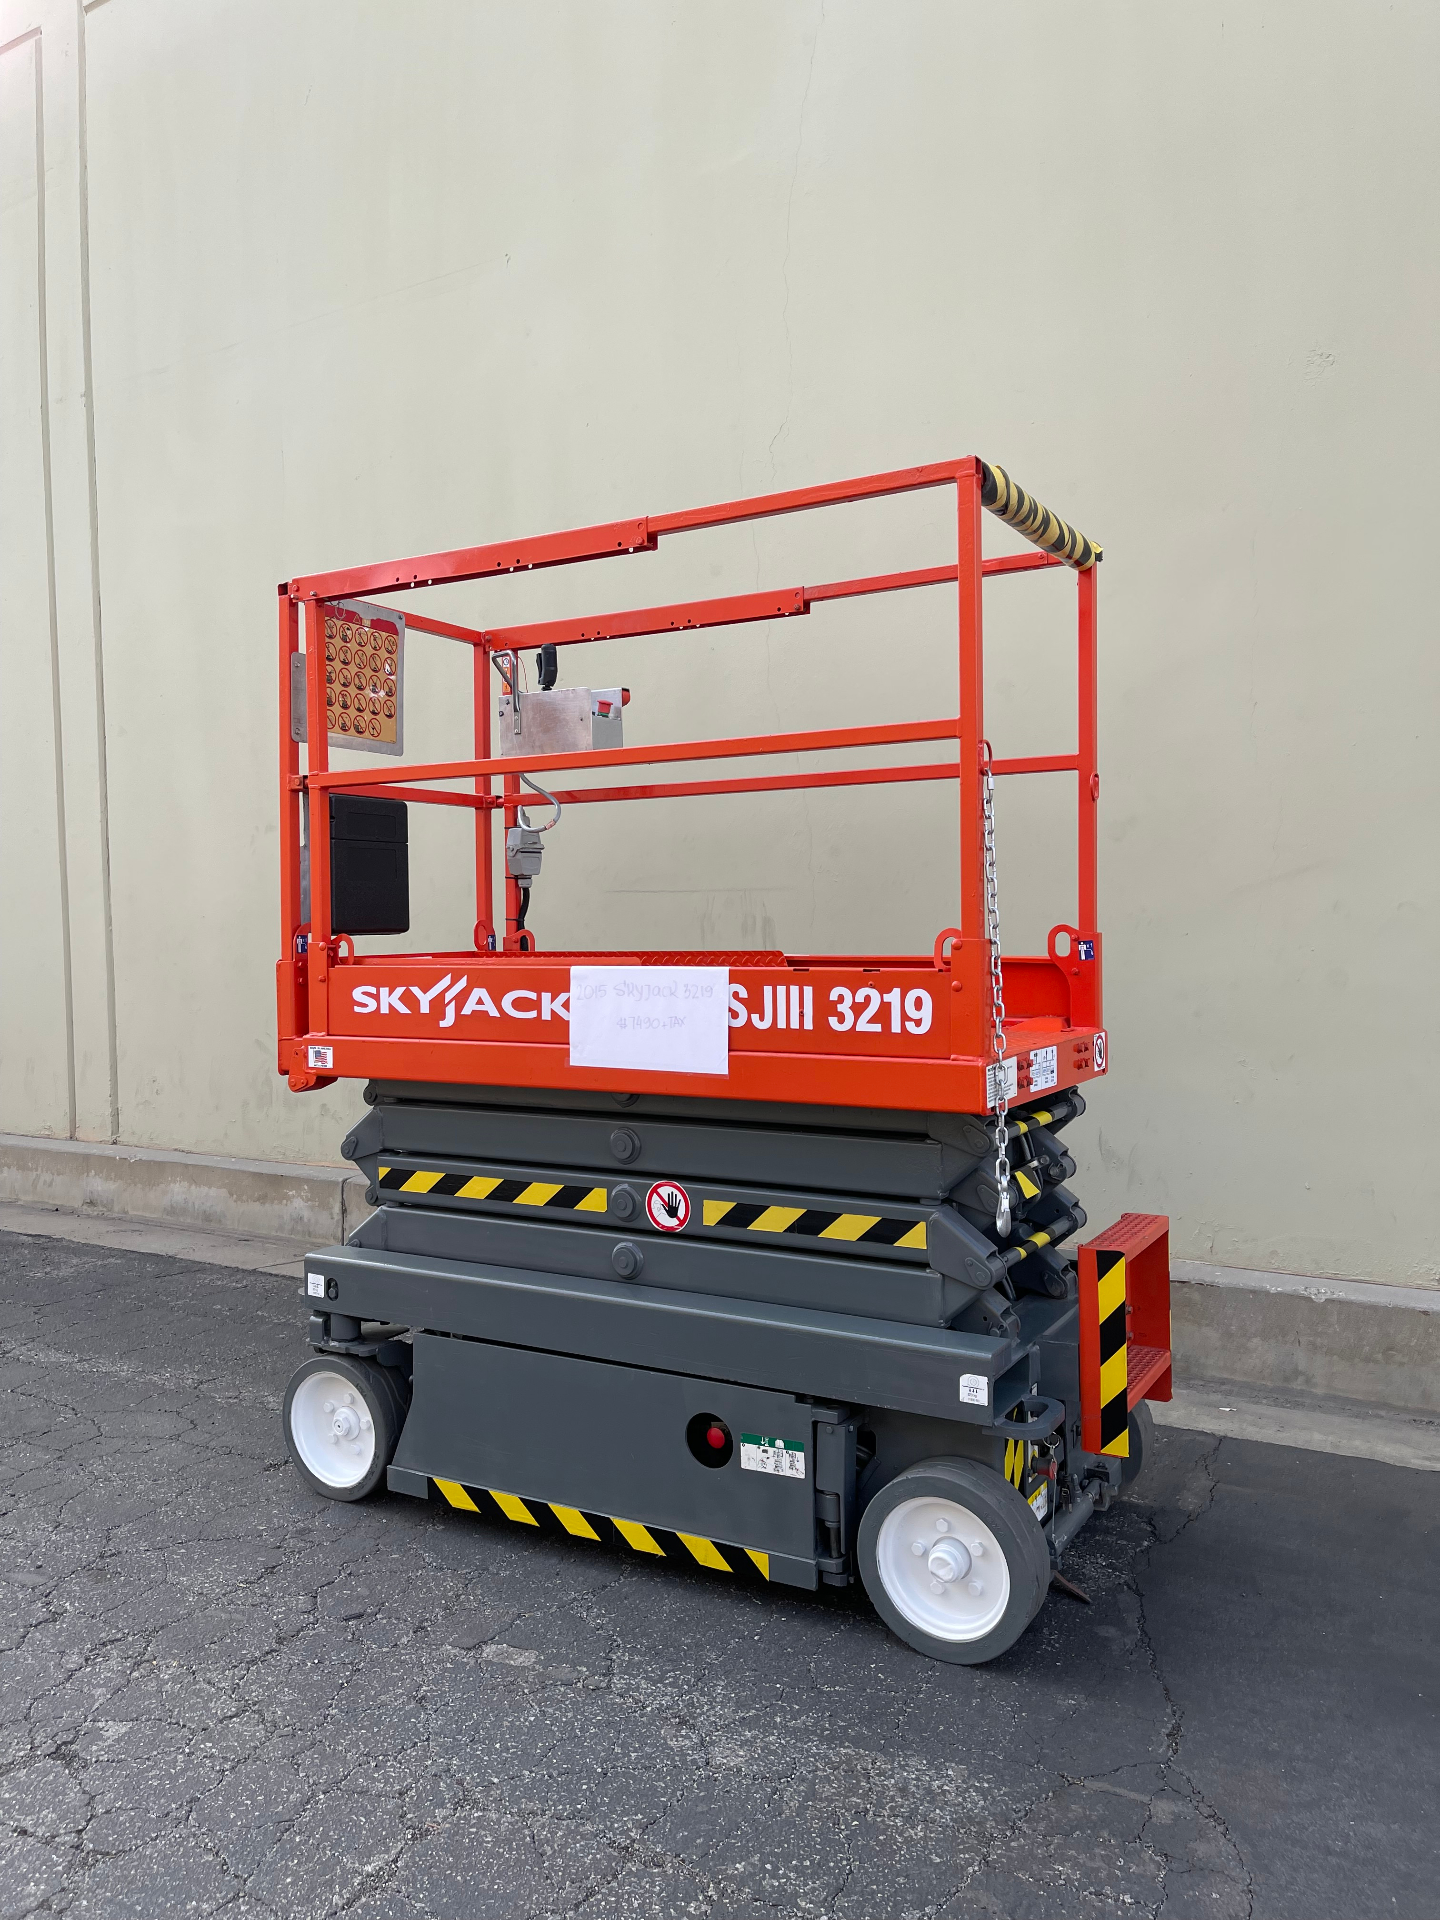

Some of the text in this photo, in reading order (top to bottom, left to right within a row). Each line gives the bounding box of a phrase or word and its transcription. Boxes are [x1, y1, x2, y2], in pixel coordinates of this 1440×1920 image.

[352, 973, 571, 1028] SKYJACK
[576, 984, 608, 1002] 2015
[683, 983, 714, 1000] 3219
[728, 983, 933, 1035] SJIII 3219
